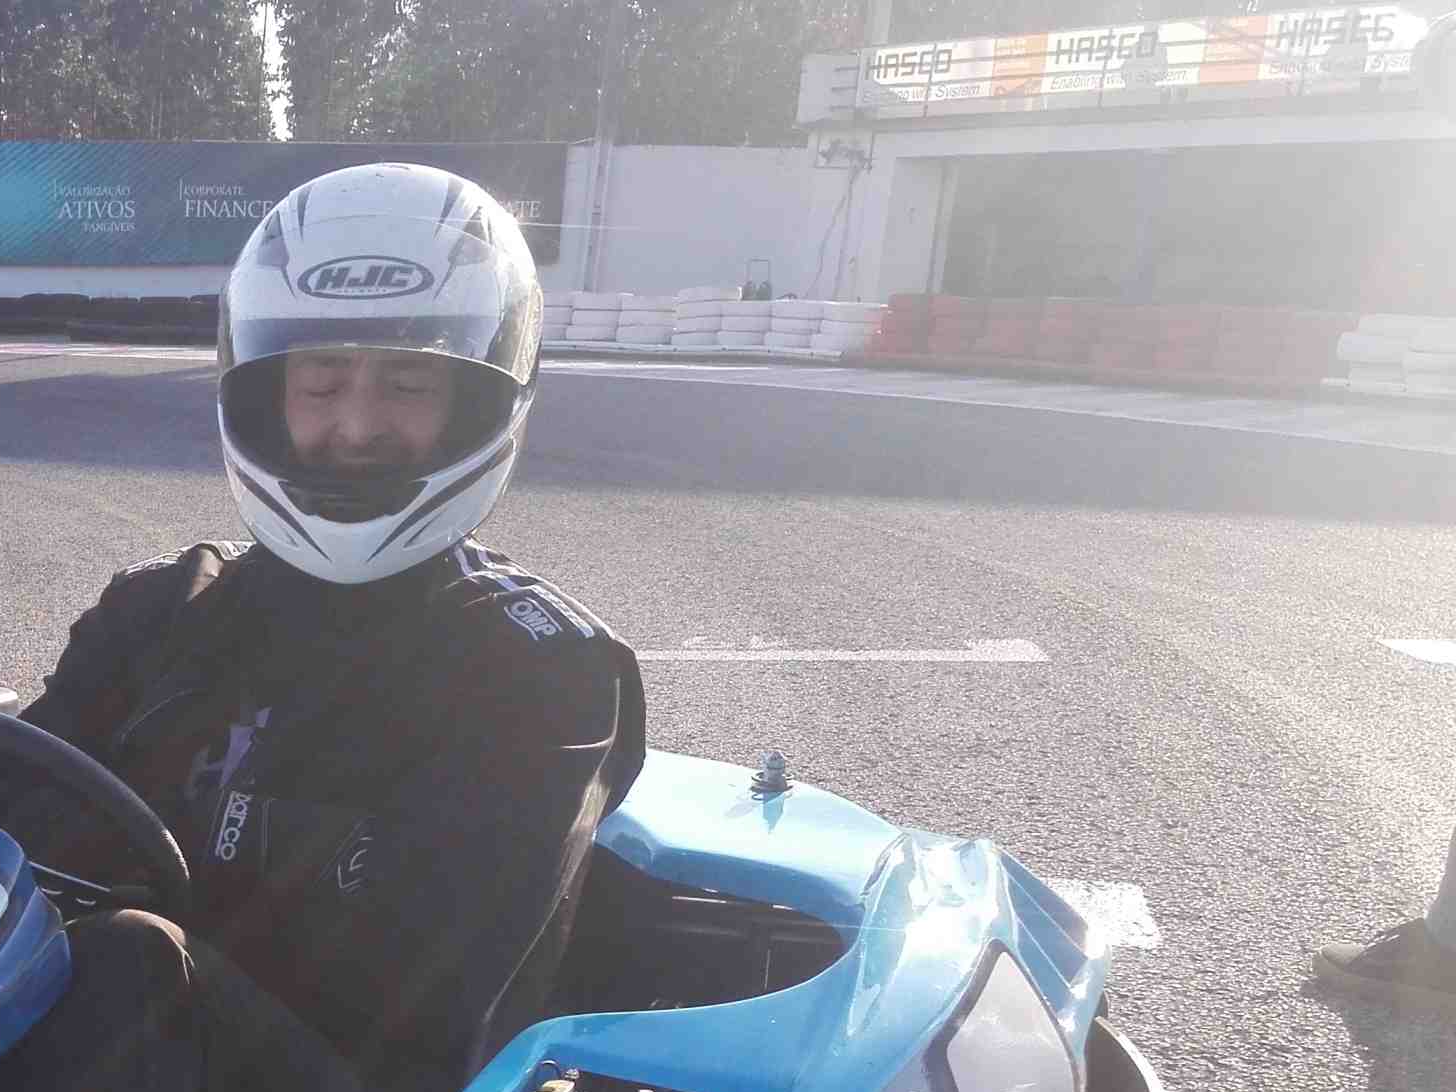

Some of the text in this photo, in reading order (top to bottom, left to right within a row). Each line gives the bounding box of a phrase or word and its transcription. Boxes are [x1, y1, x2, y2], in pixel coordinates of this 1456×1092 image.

[57, 199, 136, 220] ATIVOS
[313, 265, 416, 289] HJC
[510, 600, 557, 636] OMP
